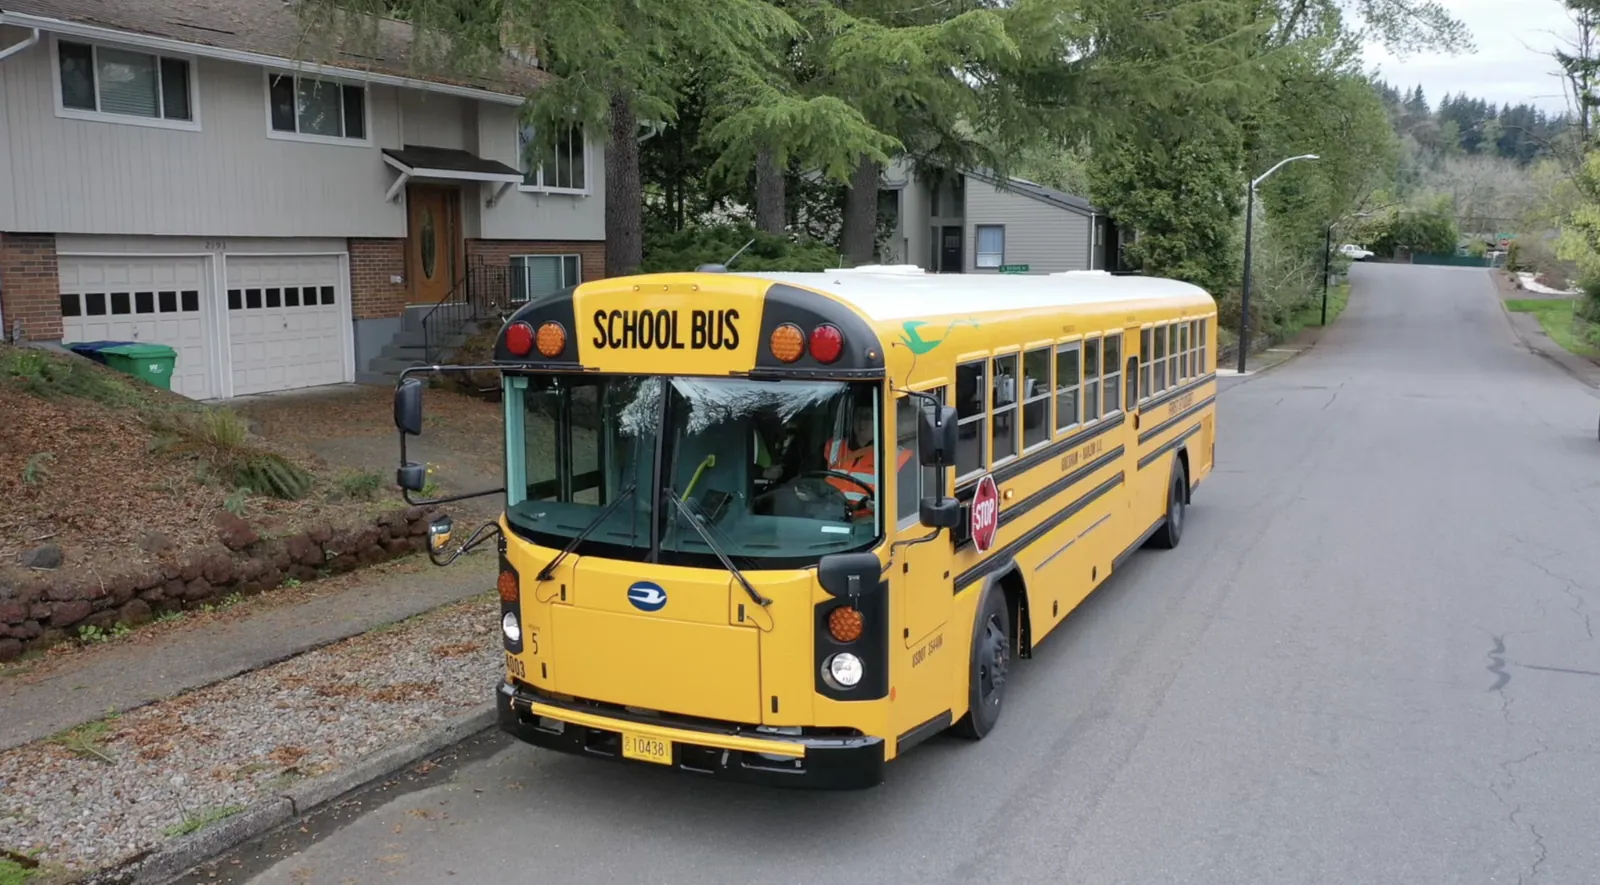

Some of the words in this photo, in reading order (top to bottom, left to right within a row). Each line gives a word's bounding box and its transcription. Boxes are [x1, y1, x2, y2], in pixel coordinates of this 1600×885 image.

[592, 309, 685, 350] SCHOOL
[691, 308, 740, 350] BUS
[974, 497, 995, 531] STOP
[532, 632, 539, 655] 5
[633, 737, 665, 757] 10438
